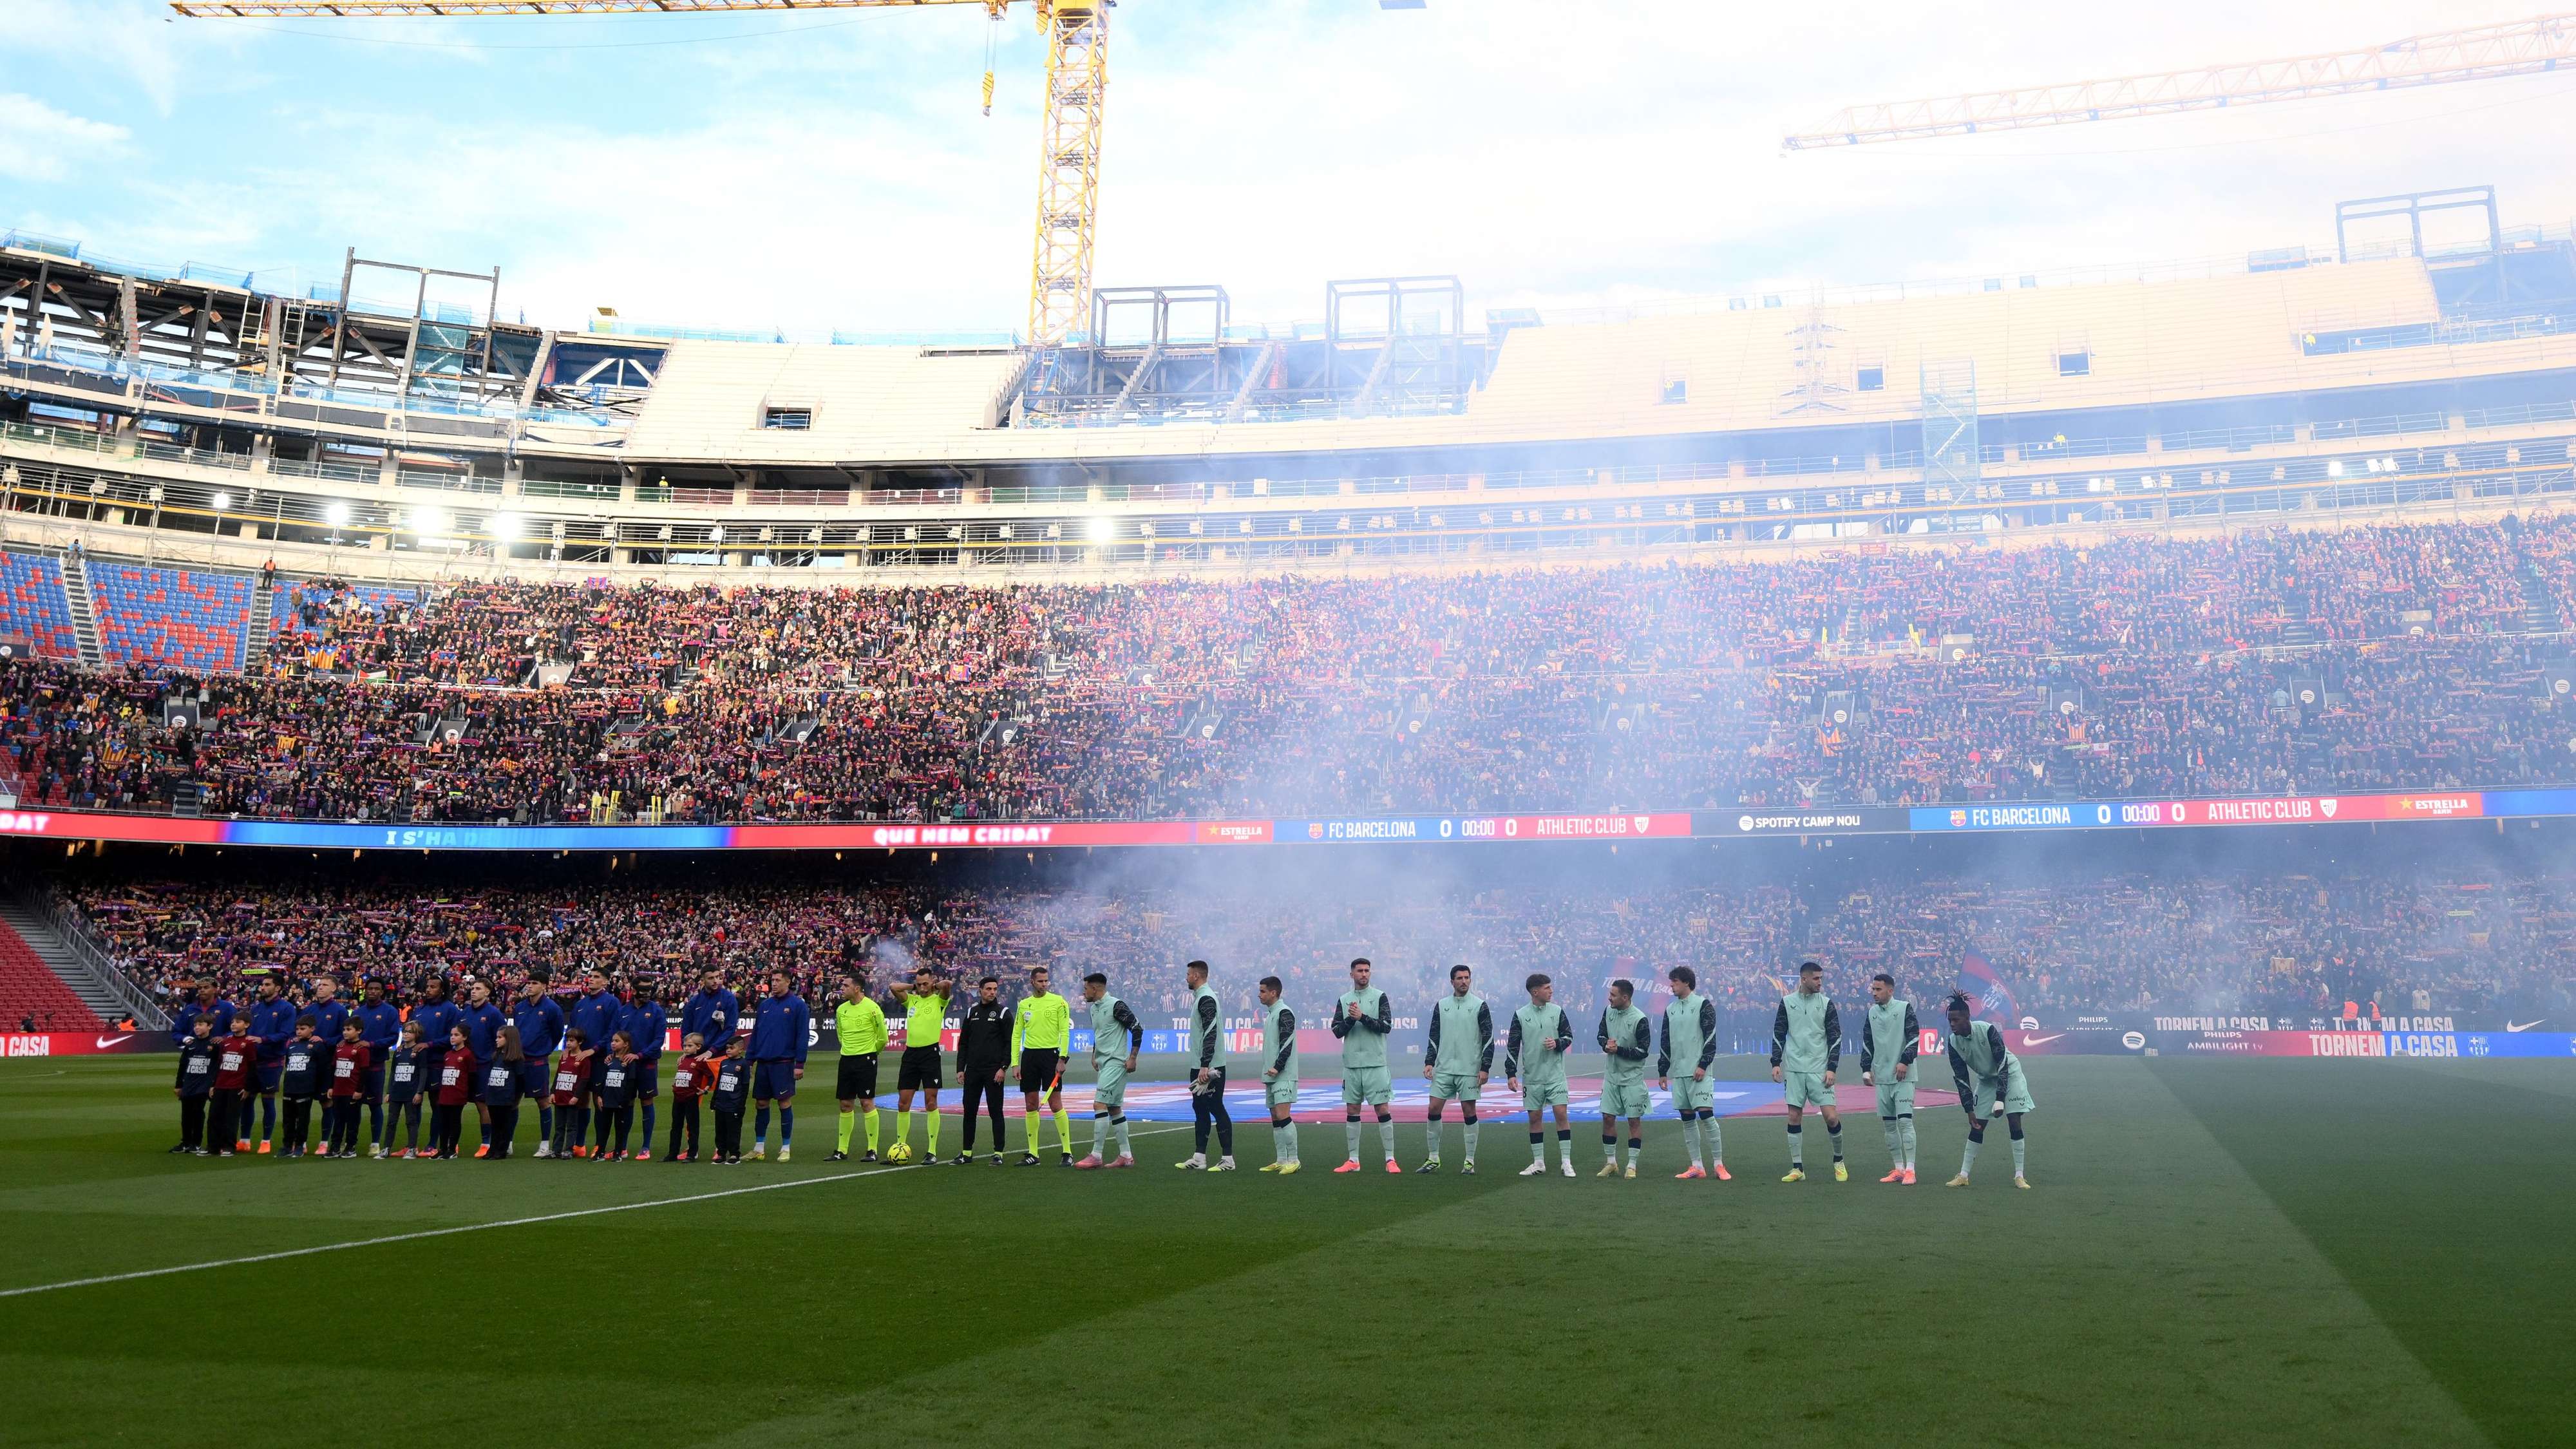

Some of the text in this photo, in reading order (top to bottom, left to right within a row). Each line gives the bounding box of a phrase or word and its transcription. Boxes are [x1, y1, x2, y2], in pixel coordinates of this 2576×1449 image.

[2415, 799, 2468, 810] ESTRELLA
[1973, 800, 2312, 826] FC BARCELONA 0 00:00 0 ATHLETIC CLUB
[1329, 817, 1626, 838] FC BARCELONA 0 00:00 0 ATHLETIC CLUB
[1756, 815, 1860, 828] SPOTIFY CAMP NOU
[874, 828, 916, 846] QUE
[974, 826, 1052, 842] CRIDAT
[1220, 826, 1262, 835] ESTRELLA
[1602, 977, 1646, 991] TOEM
[1391, 1018, 1418, 1029] ASA
[2230, 1017, 2269, 1030] CASA
[2400, 1017, 2410, 1031] A
[2413, 1017, 2454, 1031] CASA
[8, 1036, 50, 1057] CASA
[2187, 1042, 2249, 1051] AMBILIGHT
[2309, 1034, 2458, 1057] TORNEM A CASA
